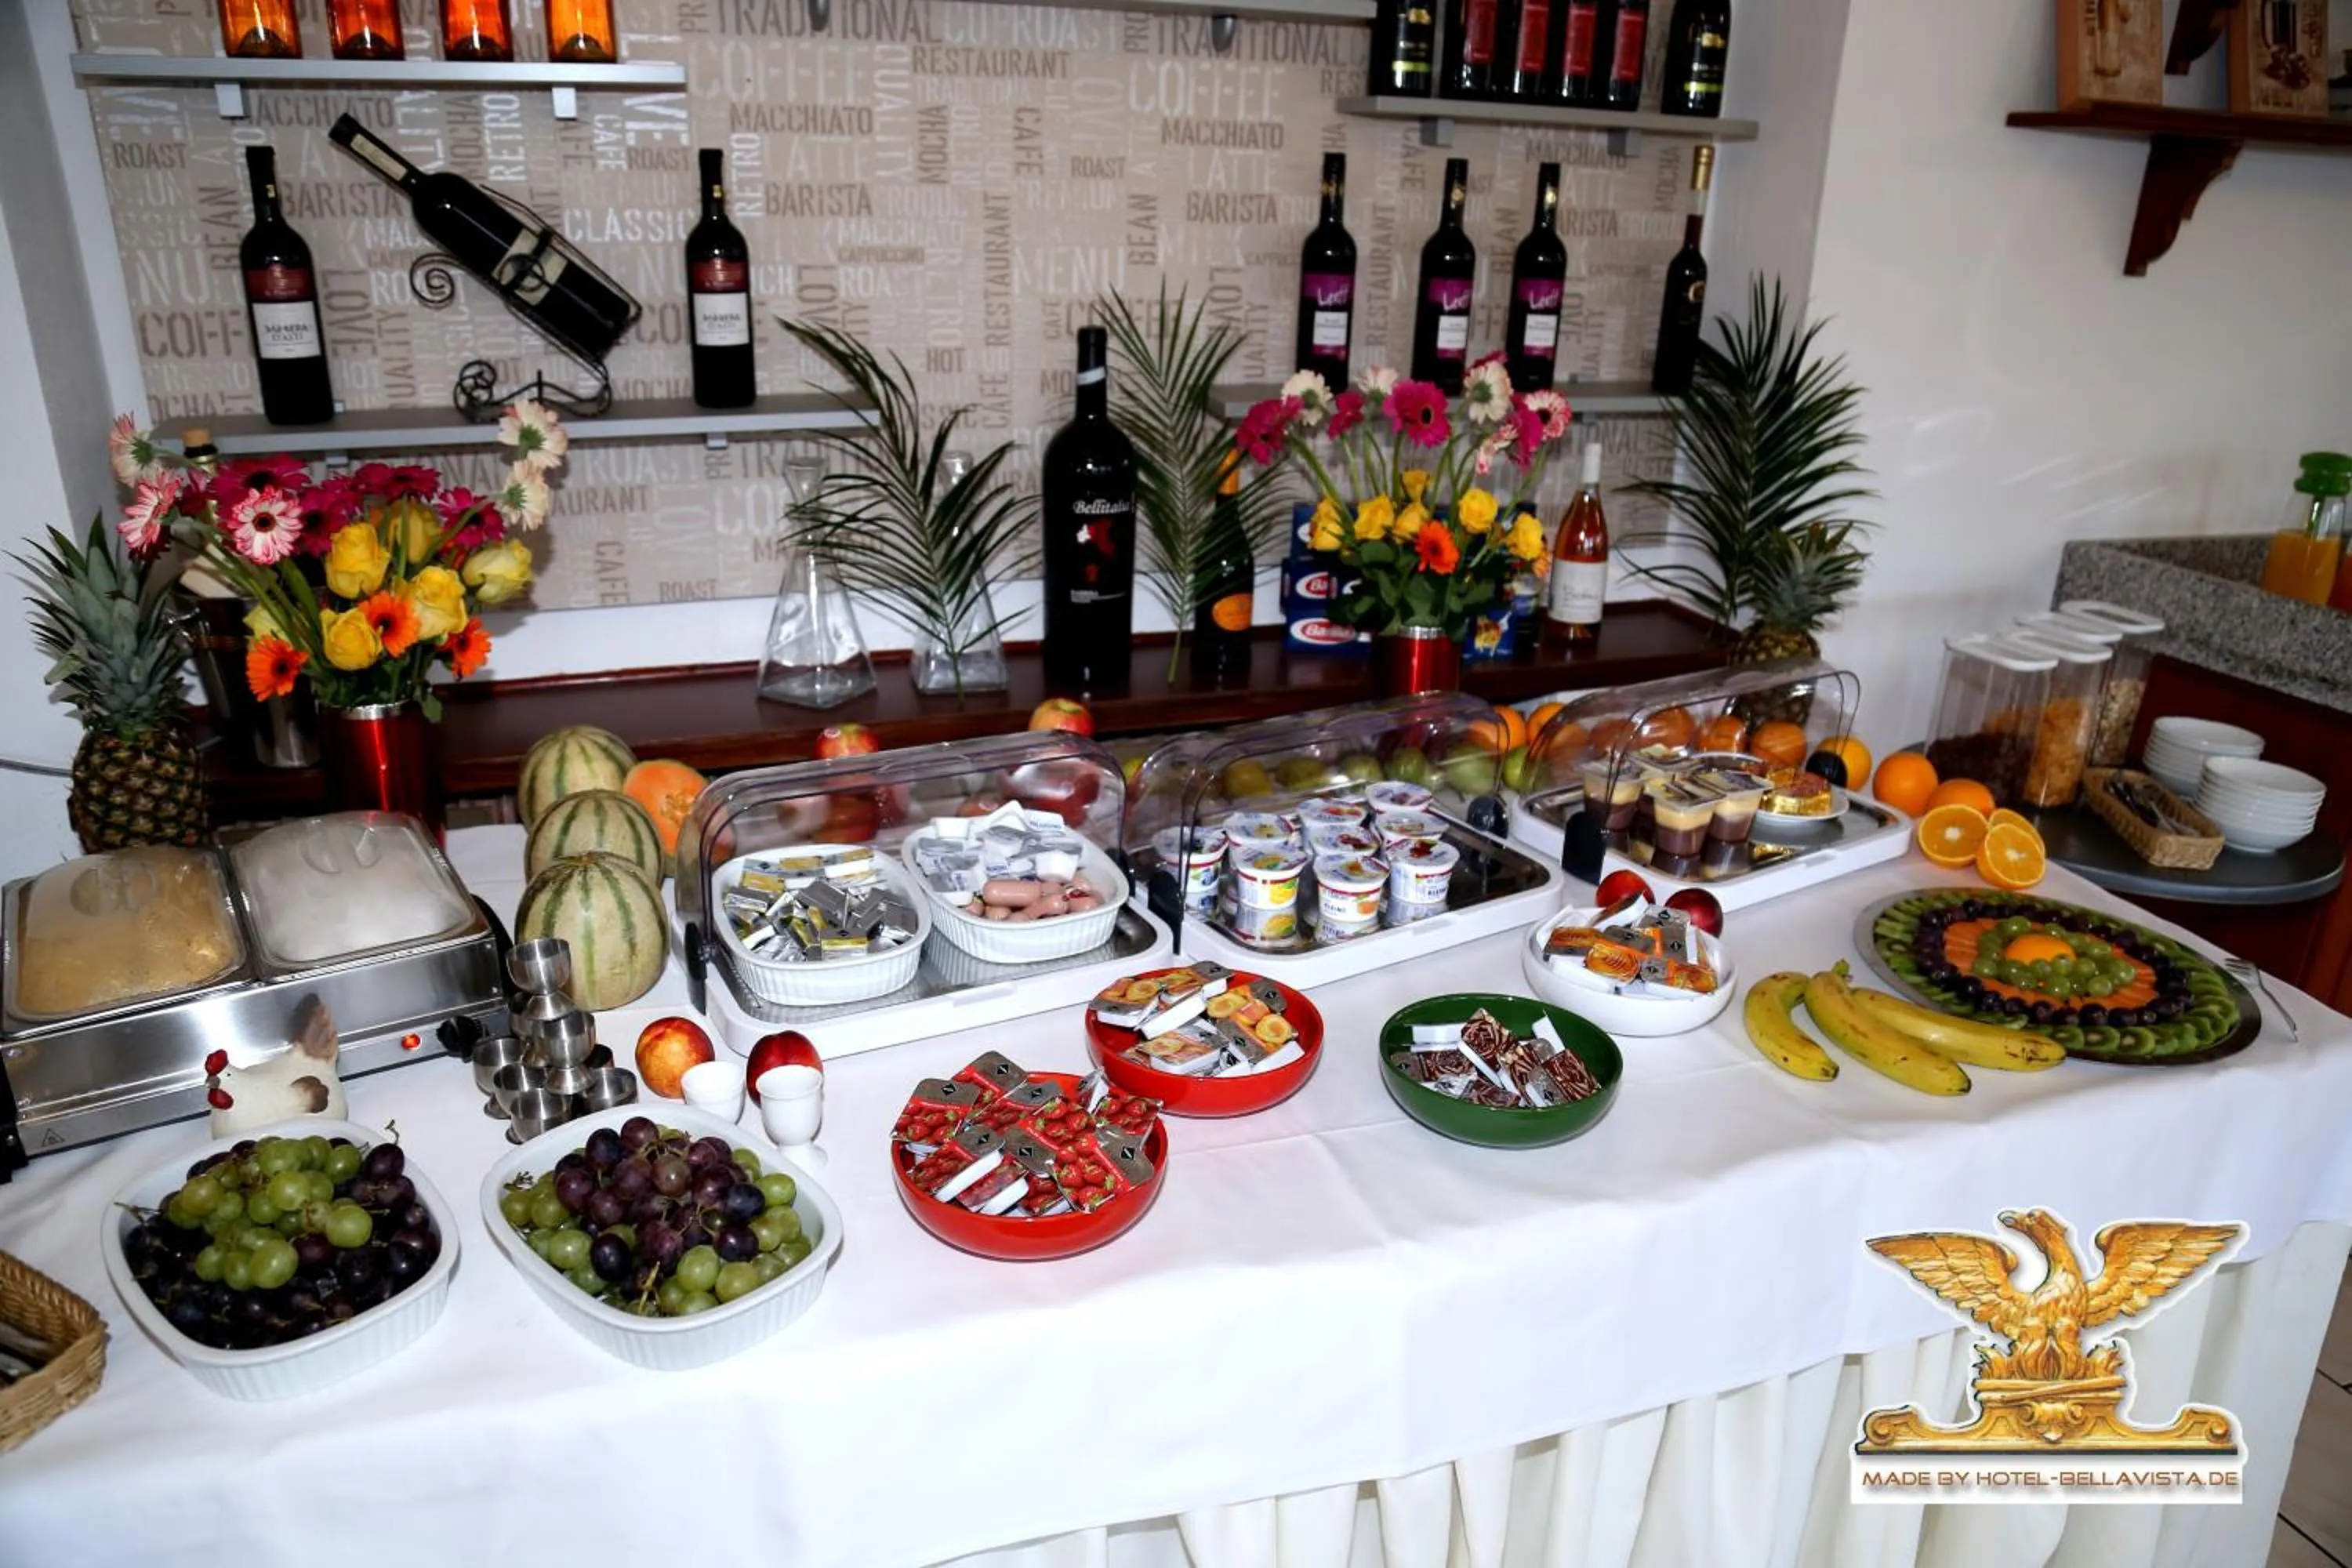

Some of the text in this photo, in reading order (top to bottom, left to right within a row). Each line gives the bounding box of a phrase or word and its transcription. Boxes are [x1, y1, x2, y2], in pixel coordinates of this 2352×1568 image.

[712, 0, 945, 42] TRADIONAL
[688, 41, 872, 104] COFFEE
[912, 45, 1071, 79] RESTAURANT
[1129, 60, 1286, 122] COFFEE
[445, 93, 487, 180] MOCHA
[481, 93, 527, 182] RETRO
[728, 102, 873, 135] MACCHIATO
[1012, 107, 1044, 176] CAFE
[1160, 118, 1284, 150] MACCHIATO
[111, 142, 187, 170] ROAST
[627, 146, 690, 172] ROAST
[762, 135, 873, 182] LATTE
[916, 104, 949, 185] MOCHA
[1070, 155, 1127, 180] ROAST
[728, 132, 767, 218] RETRO
[1187, 147, 1281, 193] LATTE
[762, 182, 873, 219] BARISTA
[1185, 192, 1278, 224] BARISTA
[1559, 209, 1619, 238] ARISTA
[560, 206, 696, 243] CLASSIC
[1127, 193, 1159, 267] BEAN
[982, 188, 1013, 347] RESTAURANT
[1011, 245, 1127, 296] MENU
[1366, 201, 1396, 347] RESTAURANT
[321, 267, 379, 357] LOVE
[926, 347, 967, 374] HOT
[978, 373, 1013, 430] CAFE
[593, 540, 630, 604] CAFE
[659, 578, 718, 603] ROAST
